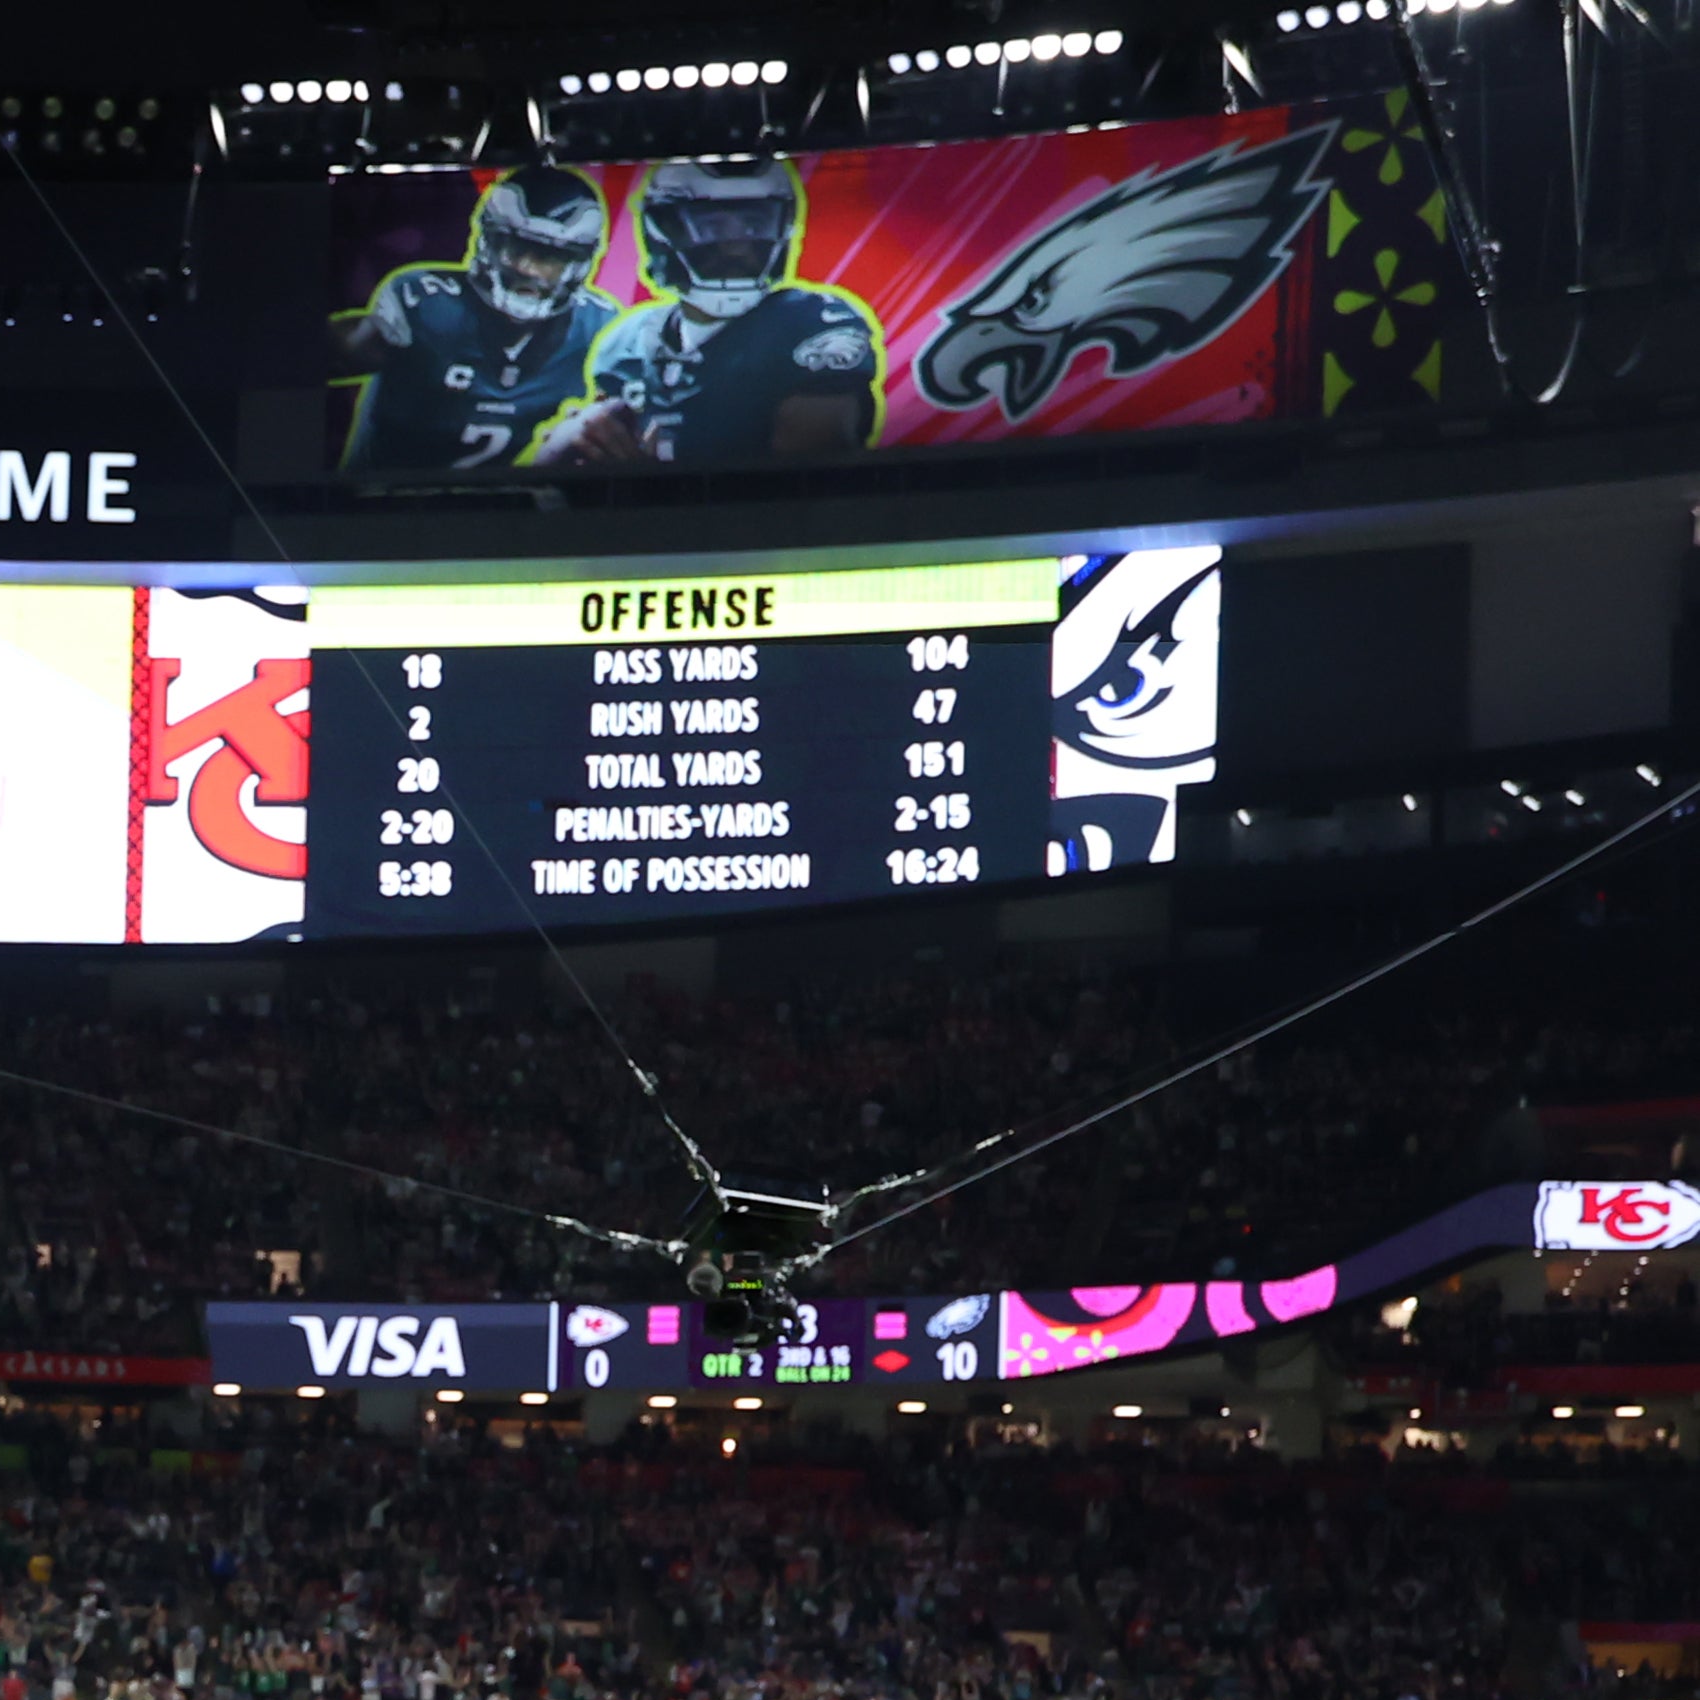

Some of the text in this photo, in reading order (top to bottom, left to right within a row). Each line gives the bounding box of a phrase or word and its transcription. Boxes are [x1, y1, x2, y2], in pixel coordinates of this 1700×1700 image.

[580, 587, 775, 632] OFFENSE
[402, 655, 440, 688] 18
[594, 645, 758, 683] PASS YARDS
[907, 635, 969, 671] 104
[409, 706, 430, 740] 2
[591, 698, 759, 736] RUSH YARDS
[913, 689, 956, 724] 47
[398, 758, 439, 792] 20
[585, 750, 761, 789] TOTAL YARDS
[905, 741, 964, 777] 151
[381, 809, 453, 844] 2-20
[556, 802, 789, 842] PENALTIES-YARDS
[895, 794, 970, 831] 2-15
[380, 861, 451, 896] 5:38
[532, 854, 809, 894] TIME OF POSSESSION
[886, 847, 979, 884] 16:24
[1579, 1188, 1669, 1242] KC
[4, 1350, 127, 1377] CAESARS
[289, 1316, 465, 1377] VISA
[703, 1353, 763, 1377] QTR 2
[936, 1341, 977, 1381] 10
[584, 1348, 609, 1388] 0
